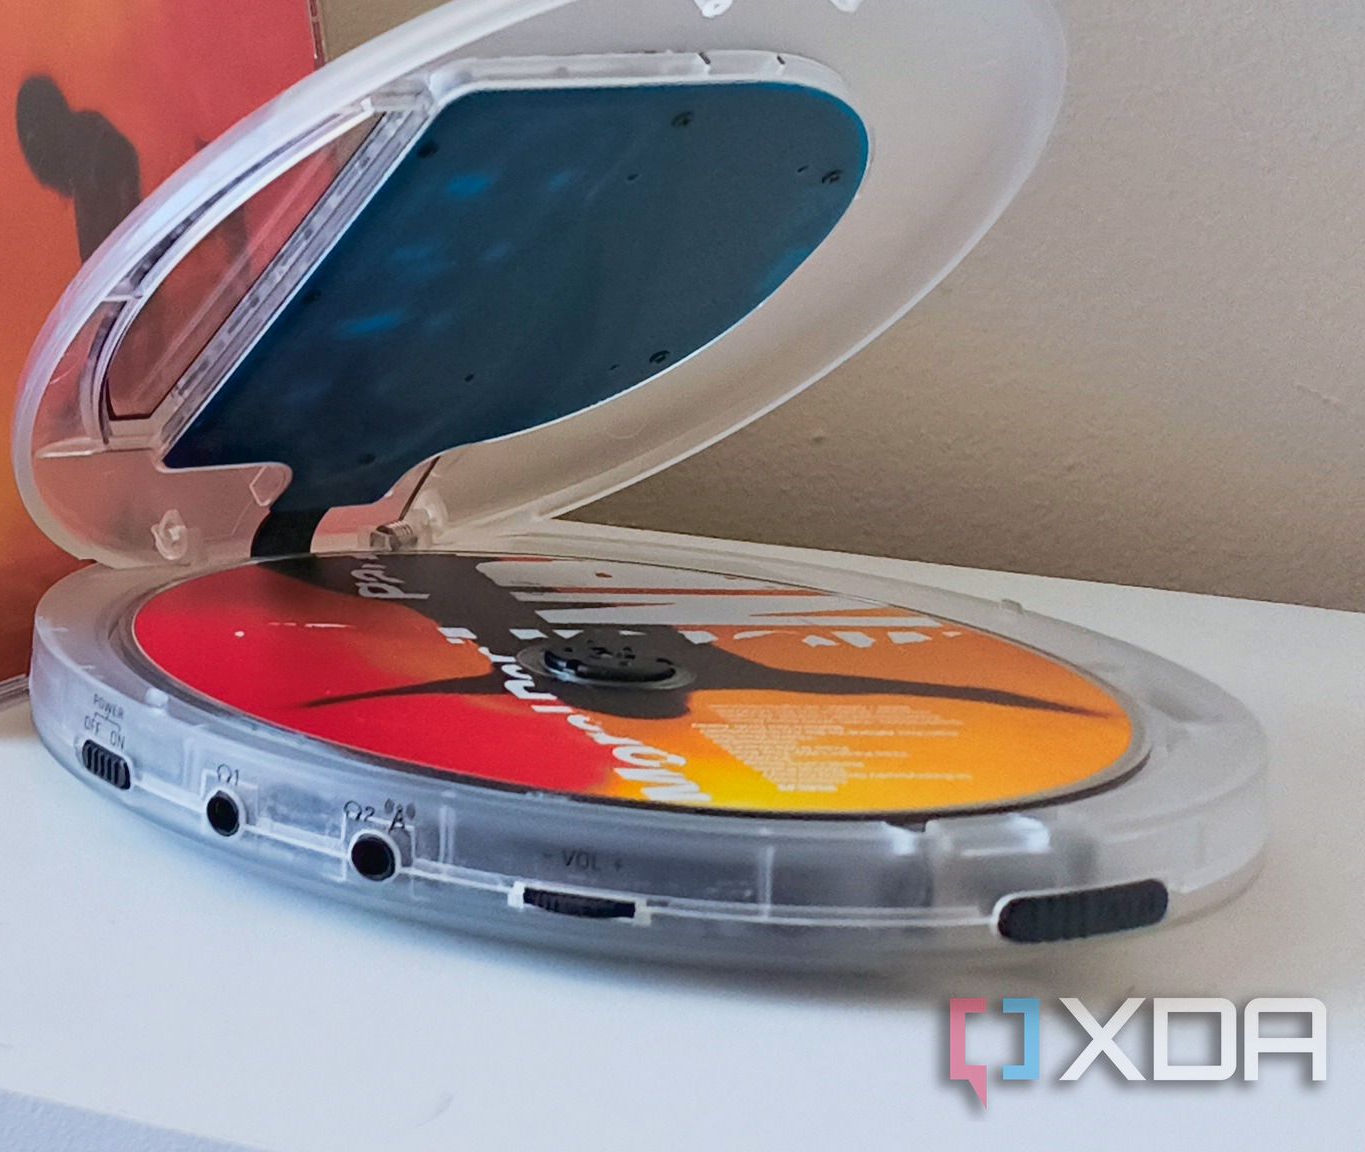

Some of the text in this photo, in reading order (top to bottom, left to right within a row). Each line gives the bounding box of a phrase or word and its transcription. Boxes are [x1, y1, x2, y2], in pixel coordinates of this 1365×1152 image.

[93, 693, 124, 720] POWER
[84, 715, 125, 750] OFF ON
[562, 849, 600, 871] VOL
